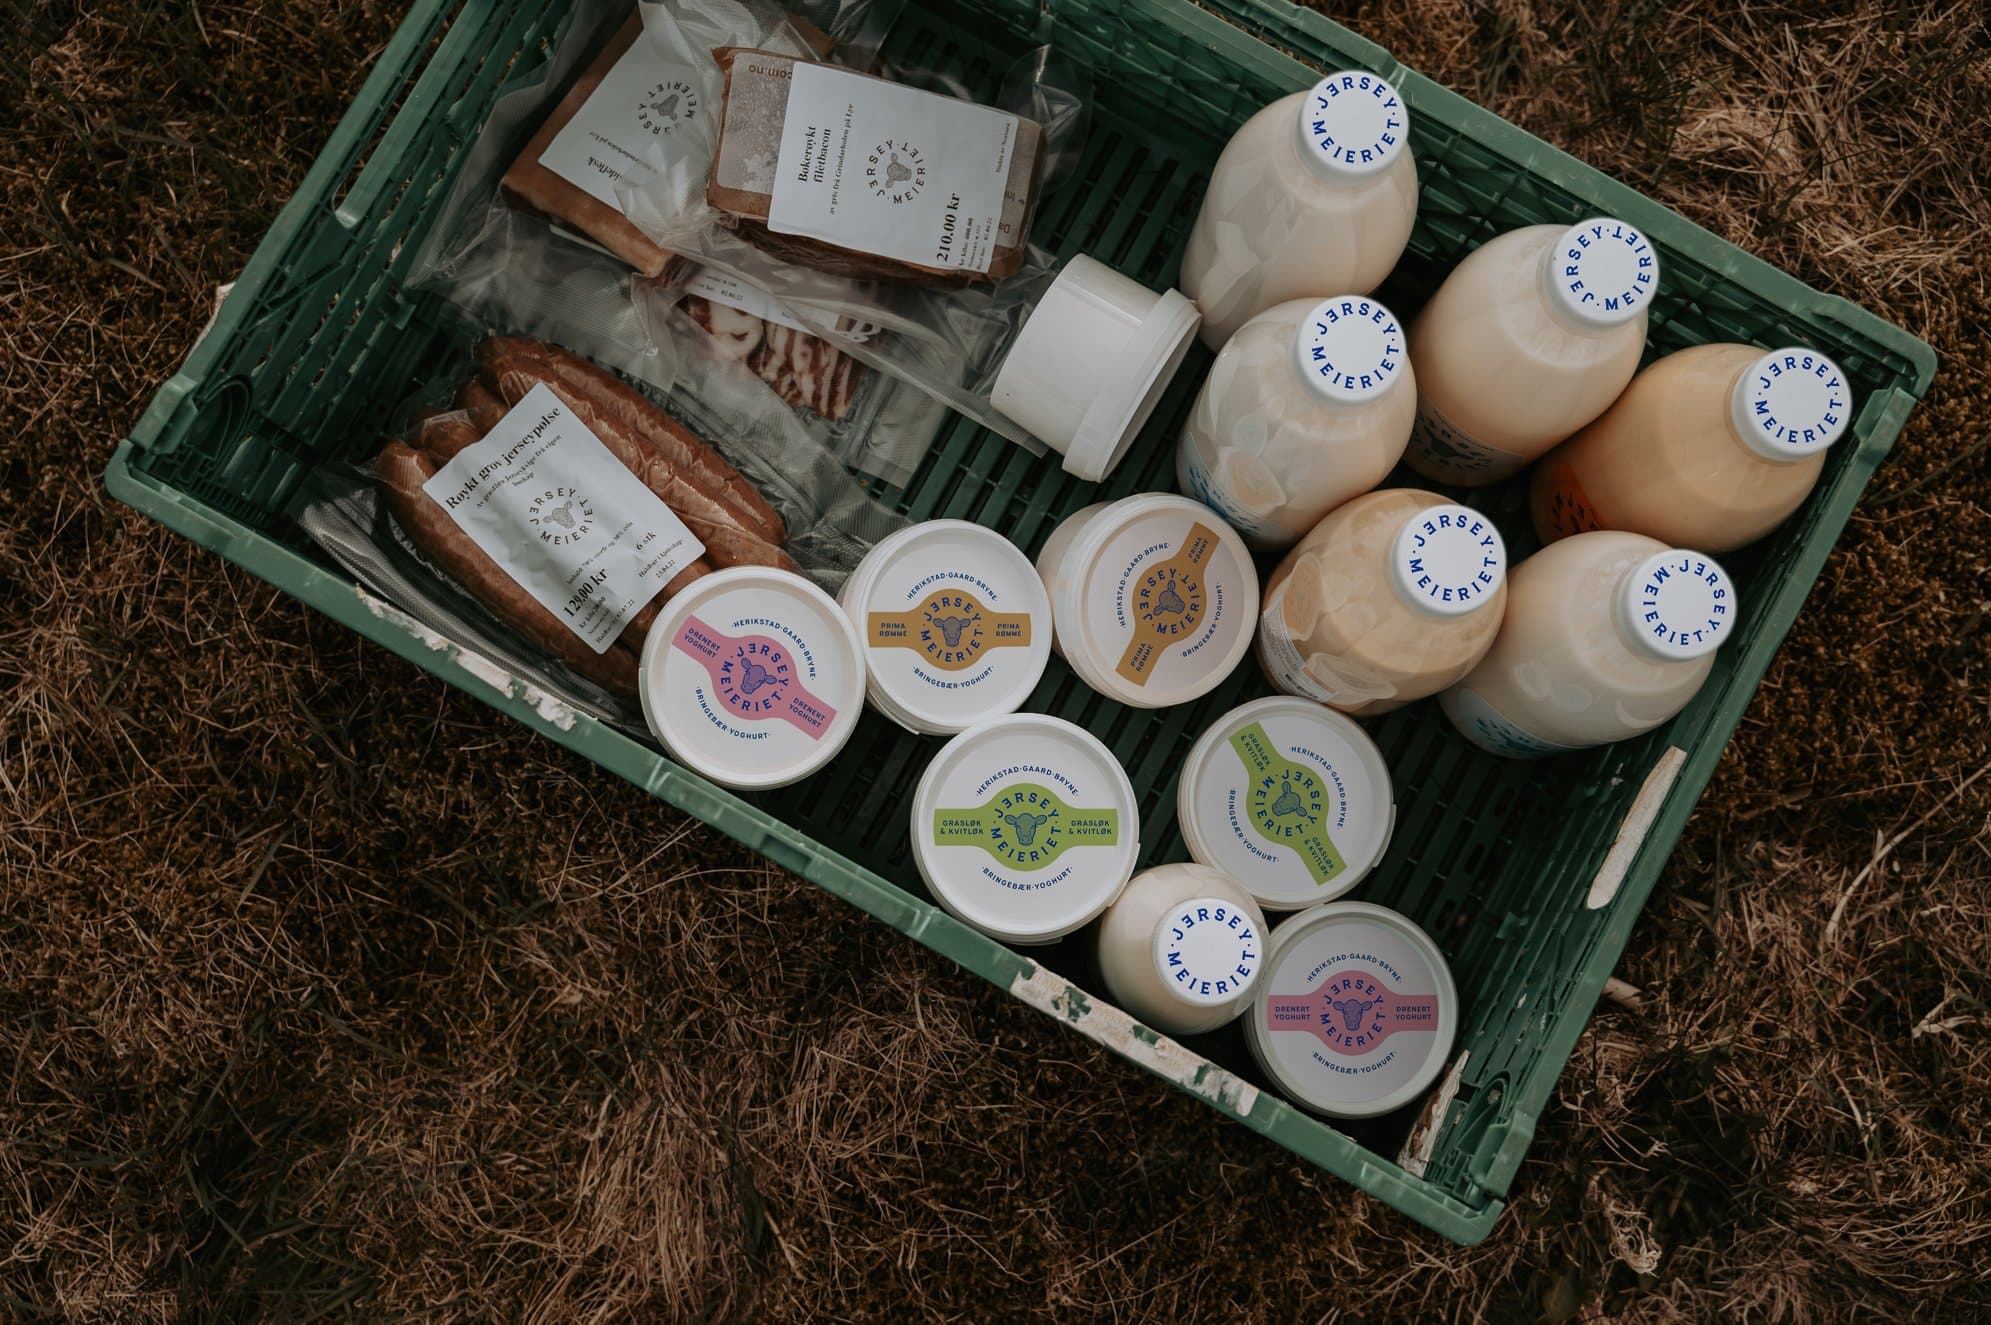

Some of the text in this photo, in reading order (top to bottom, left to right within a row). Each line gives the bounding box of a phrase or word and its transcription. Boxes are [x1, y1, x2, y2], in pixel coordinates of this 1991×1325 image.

[648, 82, 696, 118] MEIERIET
[1318, 77, 1397, 109] JERSEY
[1313, 119, 1399, 163] MEIERIET
[894, 142, 925, 204] MEIERIET
[936, 191, 960, 262] 210.00 kr
[1605, 226, 1652, 310] MEIERIET
[1317, 303, 1396, 335] JERSEY
[1312, 345, 1399, 389] MEIERIET
[1760, 357, 1840, 389] JERSEY
[1755, 399, 1842, 443] MEIERIET
[445, 407, 561, 510] Røykt grov jerseypølse
[540, 498, 593, 545] MEIERIET
[640, 529, 657, 545] stk
[1415, 515, 1494, 547] JERSEY
[1188, 537, 1202, 559] PRIMA
[1193, 539, 1209, 565] RØMME
[591, 568, 609, 587] kr
[908, 572, 997, 600] HERIKSTAD GAARD BRYNE
[1117, 542, 1169, 628] HERIKSTAD GAARD BRYNE
[1139, 568, 1177, 621] JERSEY
[1410, 557, 1496, 601] MEIERIET
[925, 597, 981, 622] JERSEY
[1157, 574, 1200, 635] MEIERIET
[1182, 584, 1222, 657] BRINGEBÆR YOGHURT
[1643, 567, 1702, 645] MEIERIET
[683, 634, 717, 659] YOGHURT
[688, 628, 721, 651] DRENERT
[733, 619, 816, 678] HERIKSTAD GAARD BRYNE
[920, 630, 983, 663] MEIERIET
[1130, 643, 1147, 666] PRIMA
[737, 643, 789, 687] JERSEY
[1136, 645, 1154, 672] RØMME
[720, 660, 782, 712] MEIERIET
[914, 666, 993, 689] BRINGEBÆR YOGHURT
[696, 688, 769, 740] BRINGEBÆR YOGHURT
[789, 704, 822, 729] YOGHURT
[793, 697, 826, 720] DRENERT
[1245, 742, 1265, 772] KVITLØK
[1248, 733, 1271, 767] GRASLØK
[978, 765, 1078, 795] HERIKSTAD GAARD BRYNE
[1281, 769, 1321, 824] JERSEY
[1291, 746, 1347, 828] HERIKSTAD GAARD BRYNE
[994, 792, 1060, 819] JERSEY
[1255, 776, 1304, 837] MEIERIET
[1229, 789, 1277, 863] BRINGEBÆR YOGHURT
[991, 826, 1061, 862] MEIERIET
[1308, 846, 1329, 876] KVITLØK
[1311, 837, 1334, 871] GRASLØK
[983, 867, 1072, 891] BRINGEBÆR YOGHURT
[1172, 908, 1252, 940] JERSEY
[1168, 950, 1255, 995] MEIERIET
[1308, 953, 1402, 982] HERIKSTAD GAARD BRYNE
[1323, 979, 1384, 1005] JERSEY
[1320, 1012, 1386, 1048] MEIERIET
[1312, 1051, 1395, 1074] BRINGEBÆR YOGHURT
